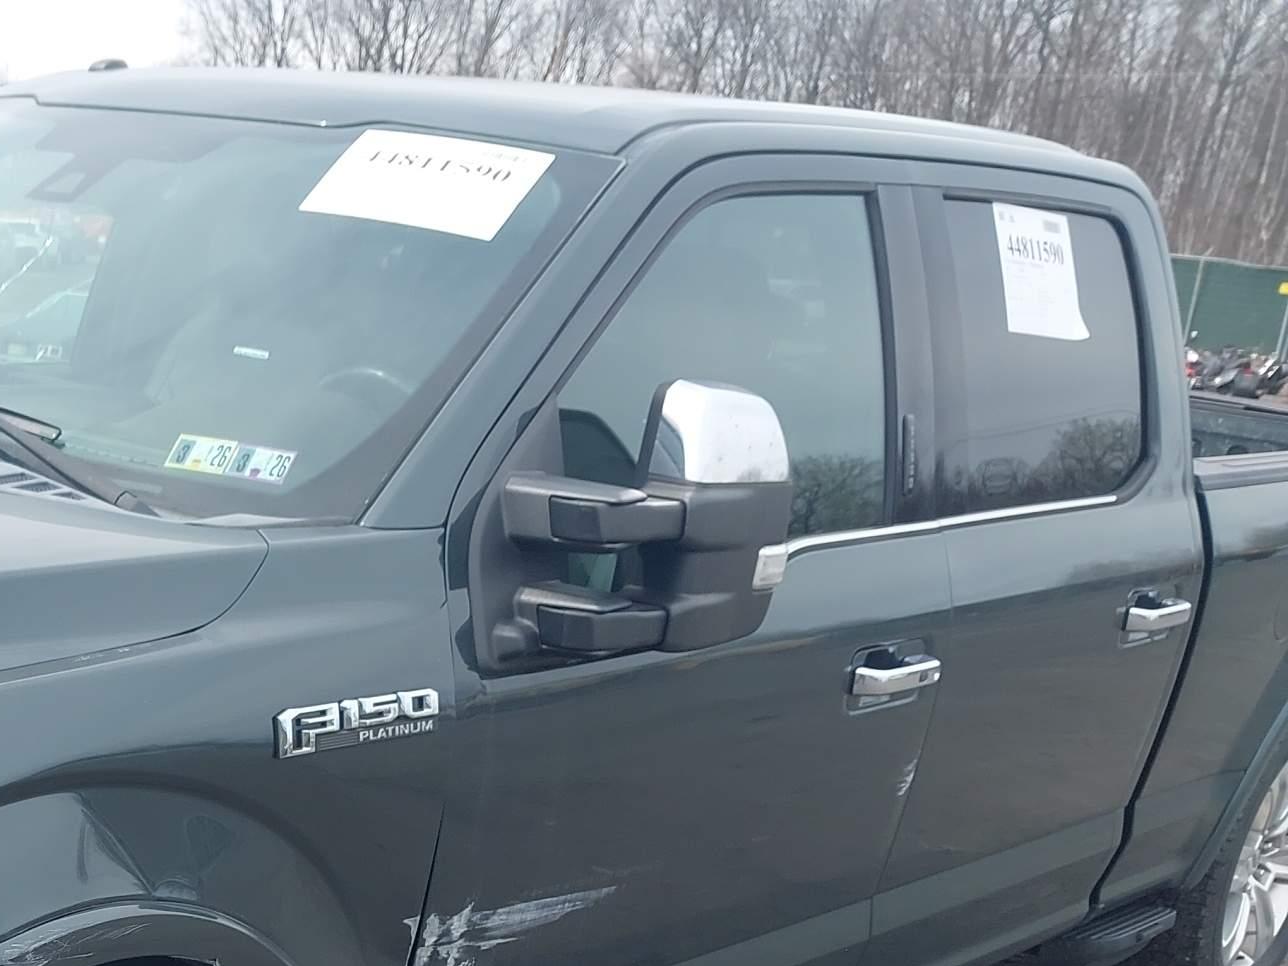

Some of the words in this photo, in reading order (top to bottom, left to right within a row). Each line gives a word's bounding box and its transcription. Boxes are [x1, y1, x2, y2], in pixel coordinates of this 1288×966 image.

[1007, 234, 1065, 265] 44811590
[175, 444, 191, 463] 3
[209, 445, 232, 468] 26
[235, 453, 250, 473] 3
[268, 454, 291, 478] 26
[358, 720, 434, 743] PLATINUM
